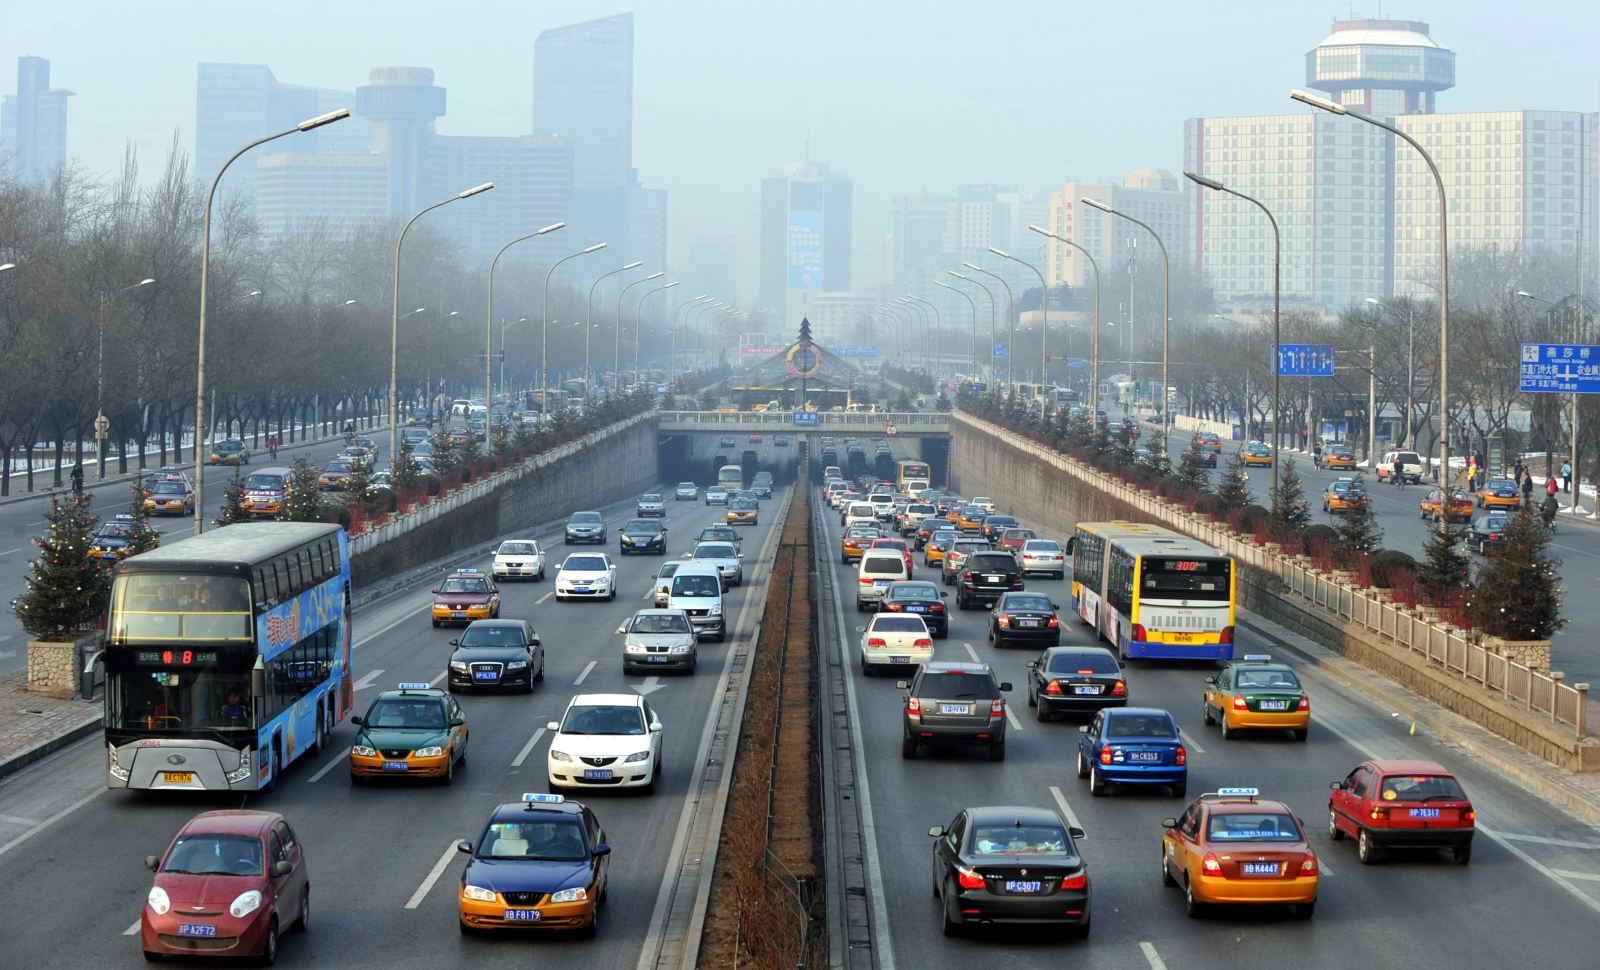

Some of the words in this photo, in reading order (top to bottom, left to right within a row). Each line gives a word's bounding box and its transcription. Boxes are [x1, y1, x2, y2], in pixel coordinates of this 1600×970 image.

[1577, 365, 1600, 376] 农业展
[1176, 561, 1197, 571] 300
[182, 650, 192, 664] 8
